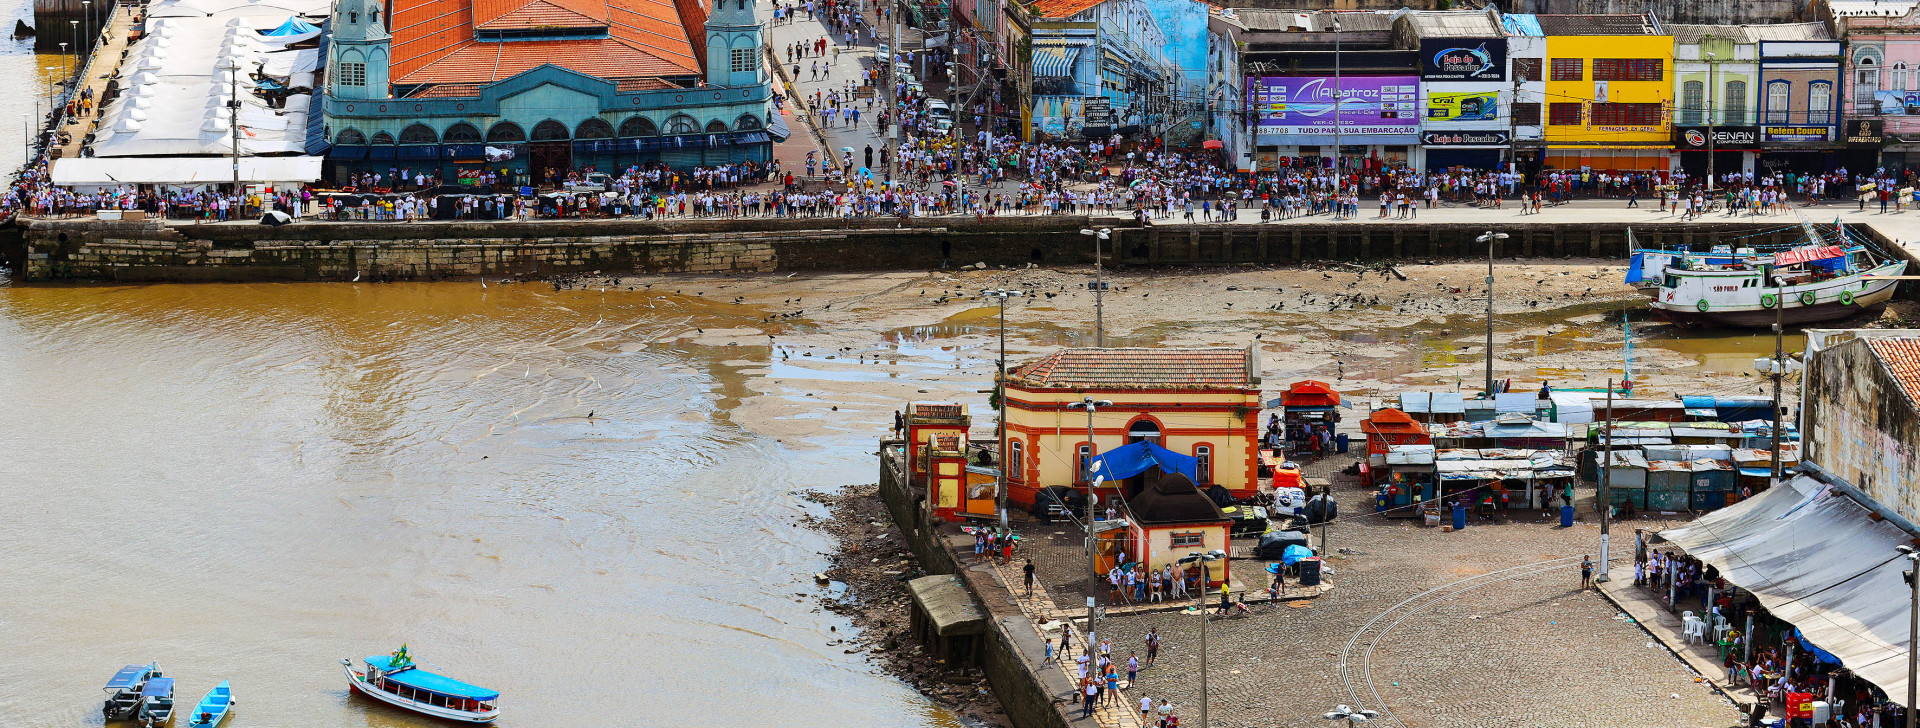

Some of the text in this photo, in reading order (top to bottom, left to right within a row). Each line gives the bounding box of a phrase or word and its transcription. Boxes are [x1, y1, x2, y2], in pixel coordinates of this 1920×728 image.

[1444, 55, 1473, 64] Loja do
[1444, 63, 1480, 71] Pescador
[1320, 87, 1379, 98] Albatroz
[1362, 126, 1415, 135] EMBARCAÇÃO
[1767, 127, 1827, 135] Belém Couros
[1434, 134, 1498, 144] Loja do Pescador
[1708, 131, 1754, 140] RENAN
